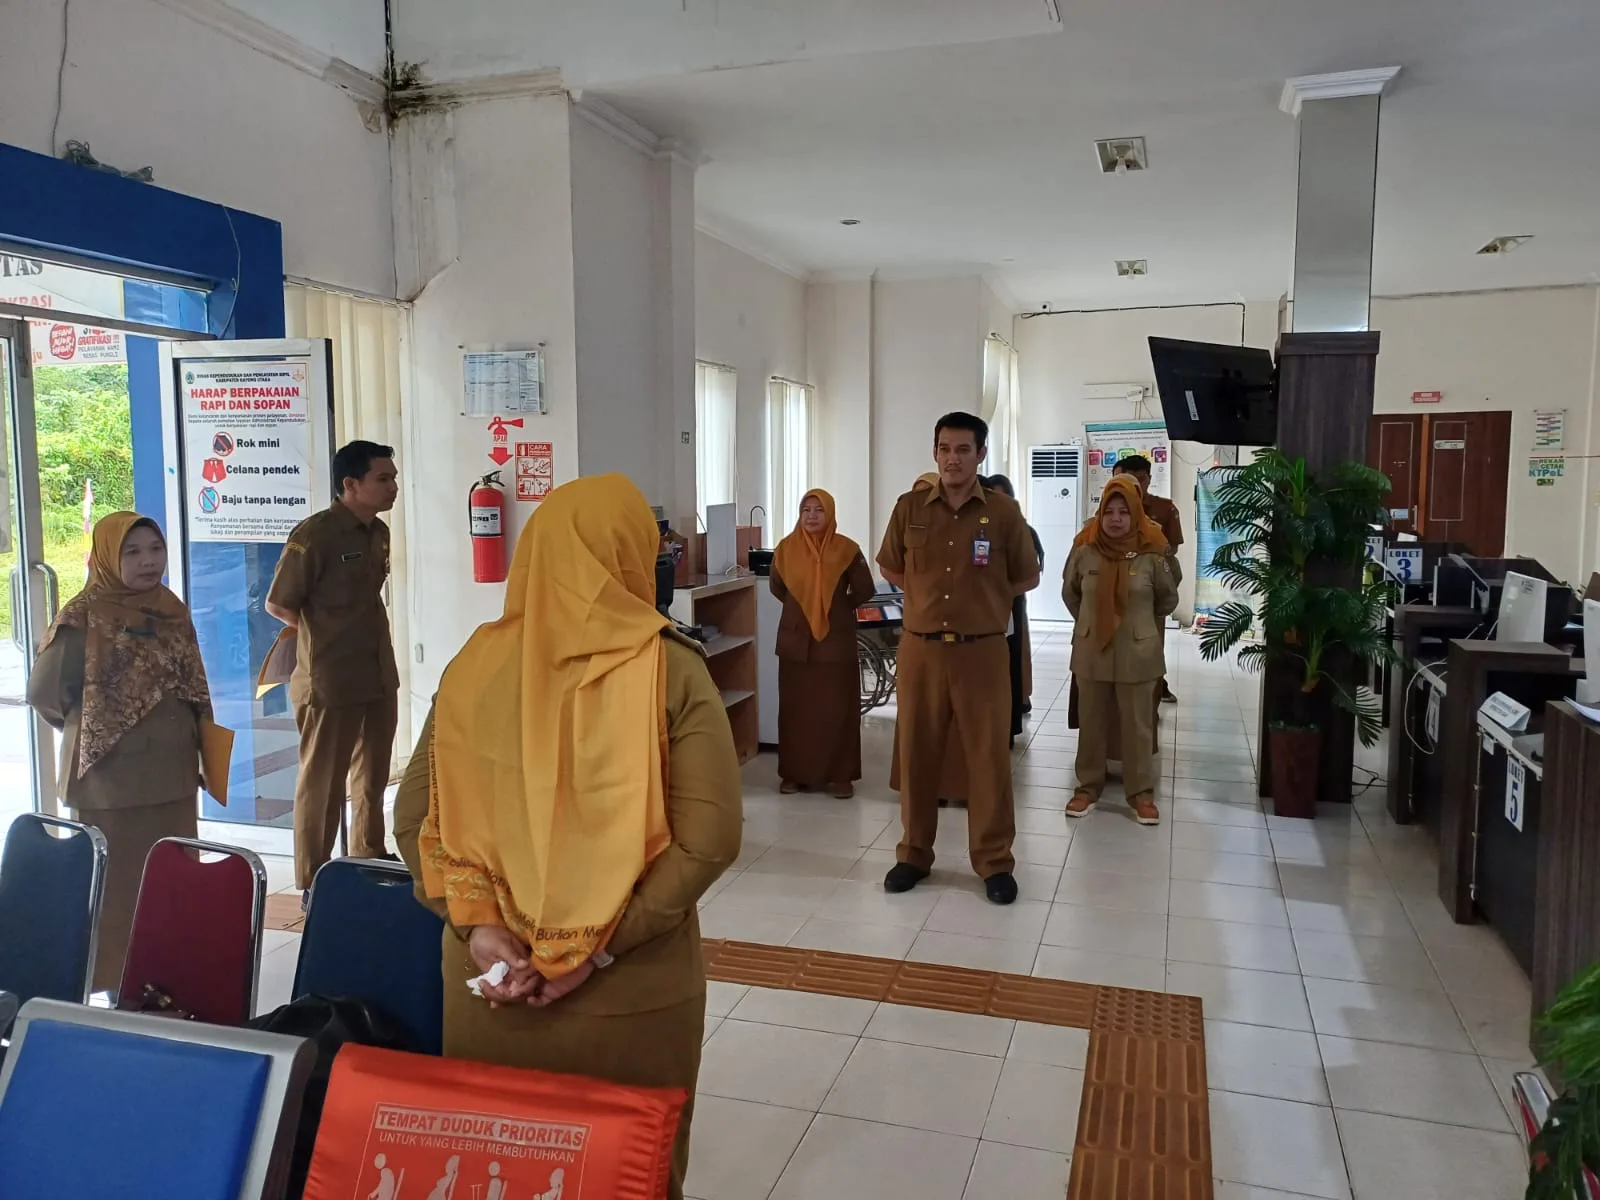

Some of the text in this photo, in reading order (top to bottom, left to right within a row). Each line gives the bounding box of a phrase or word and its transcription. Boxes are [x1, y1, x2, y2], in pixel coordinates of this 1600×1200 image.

[190, 387, 300, 398] HARAP BERPAKAIAN
[200, 399, 291, 410] RAPI DAN SOPAN
[236, 438, 280, 448] Rok mini
[226, 465, 300, 475] Celana pendek
[221, 495, 306, 506] Baju tanpa lengan
[1397, 558, 1411, 581] 3
[1508, 759, 1524, 785] LOKET
[1510, 781, 1519, 823] 5
[378, 1110, 584, 1147] TEMPAT DUDUK PRIORITAS
[379, 1131, 575, 1164] UNTUK YANG LEBIH MEMBUTUHKAN
